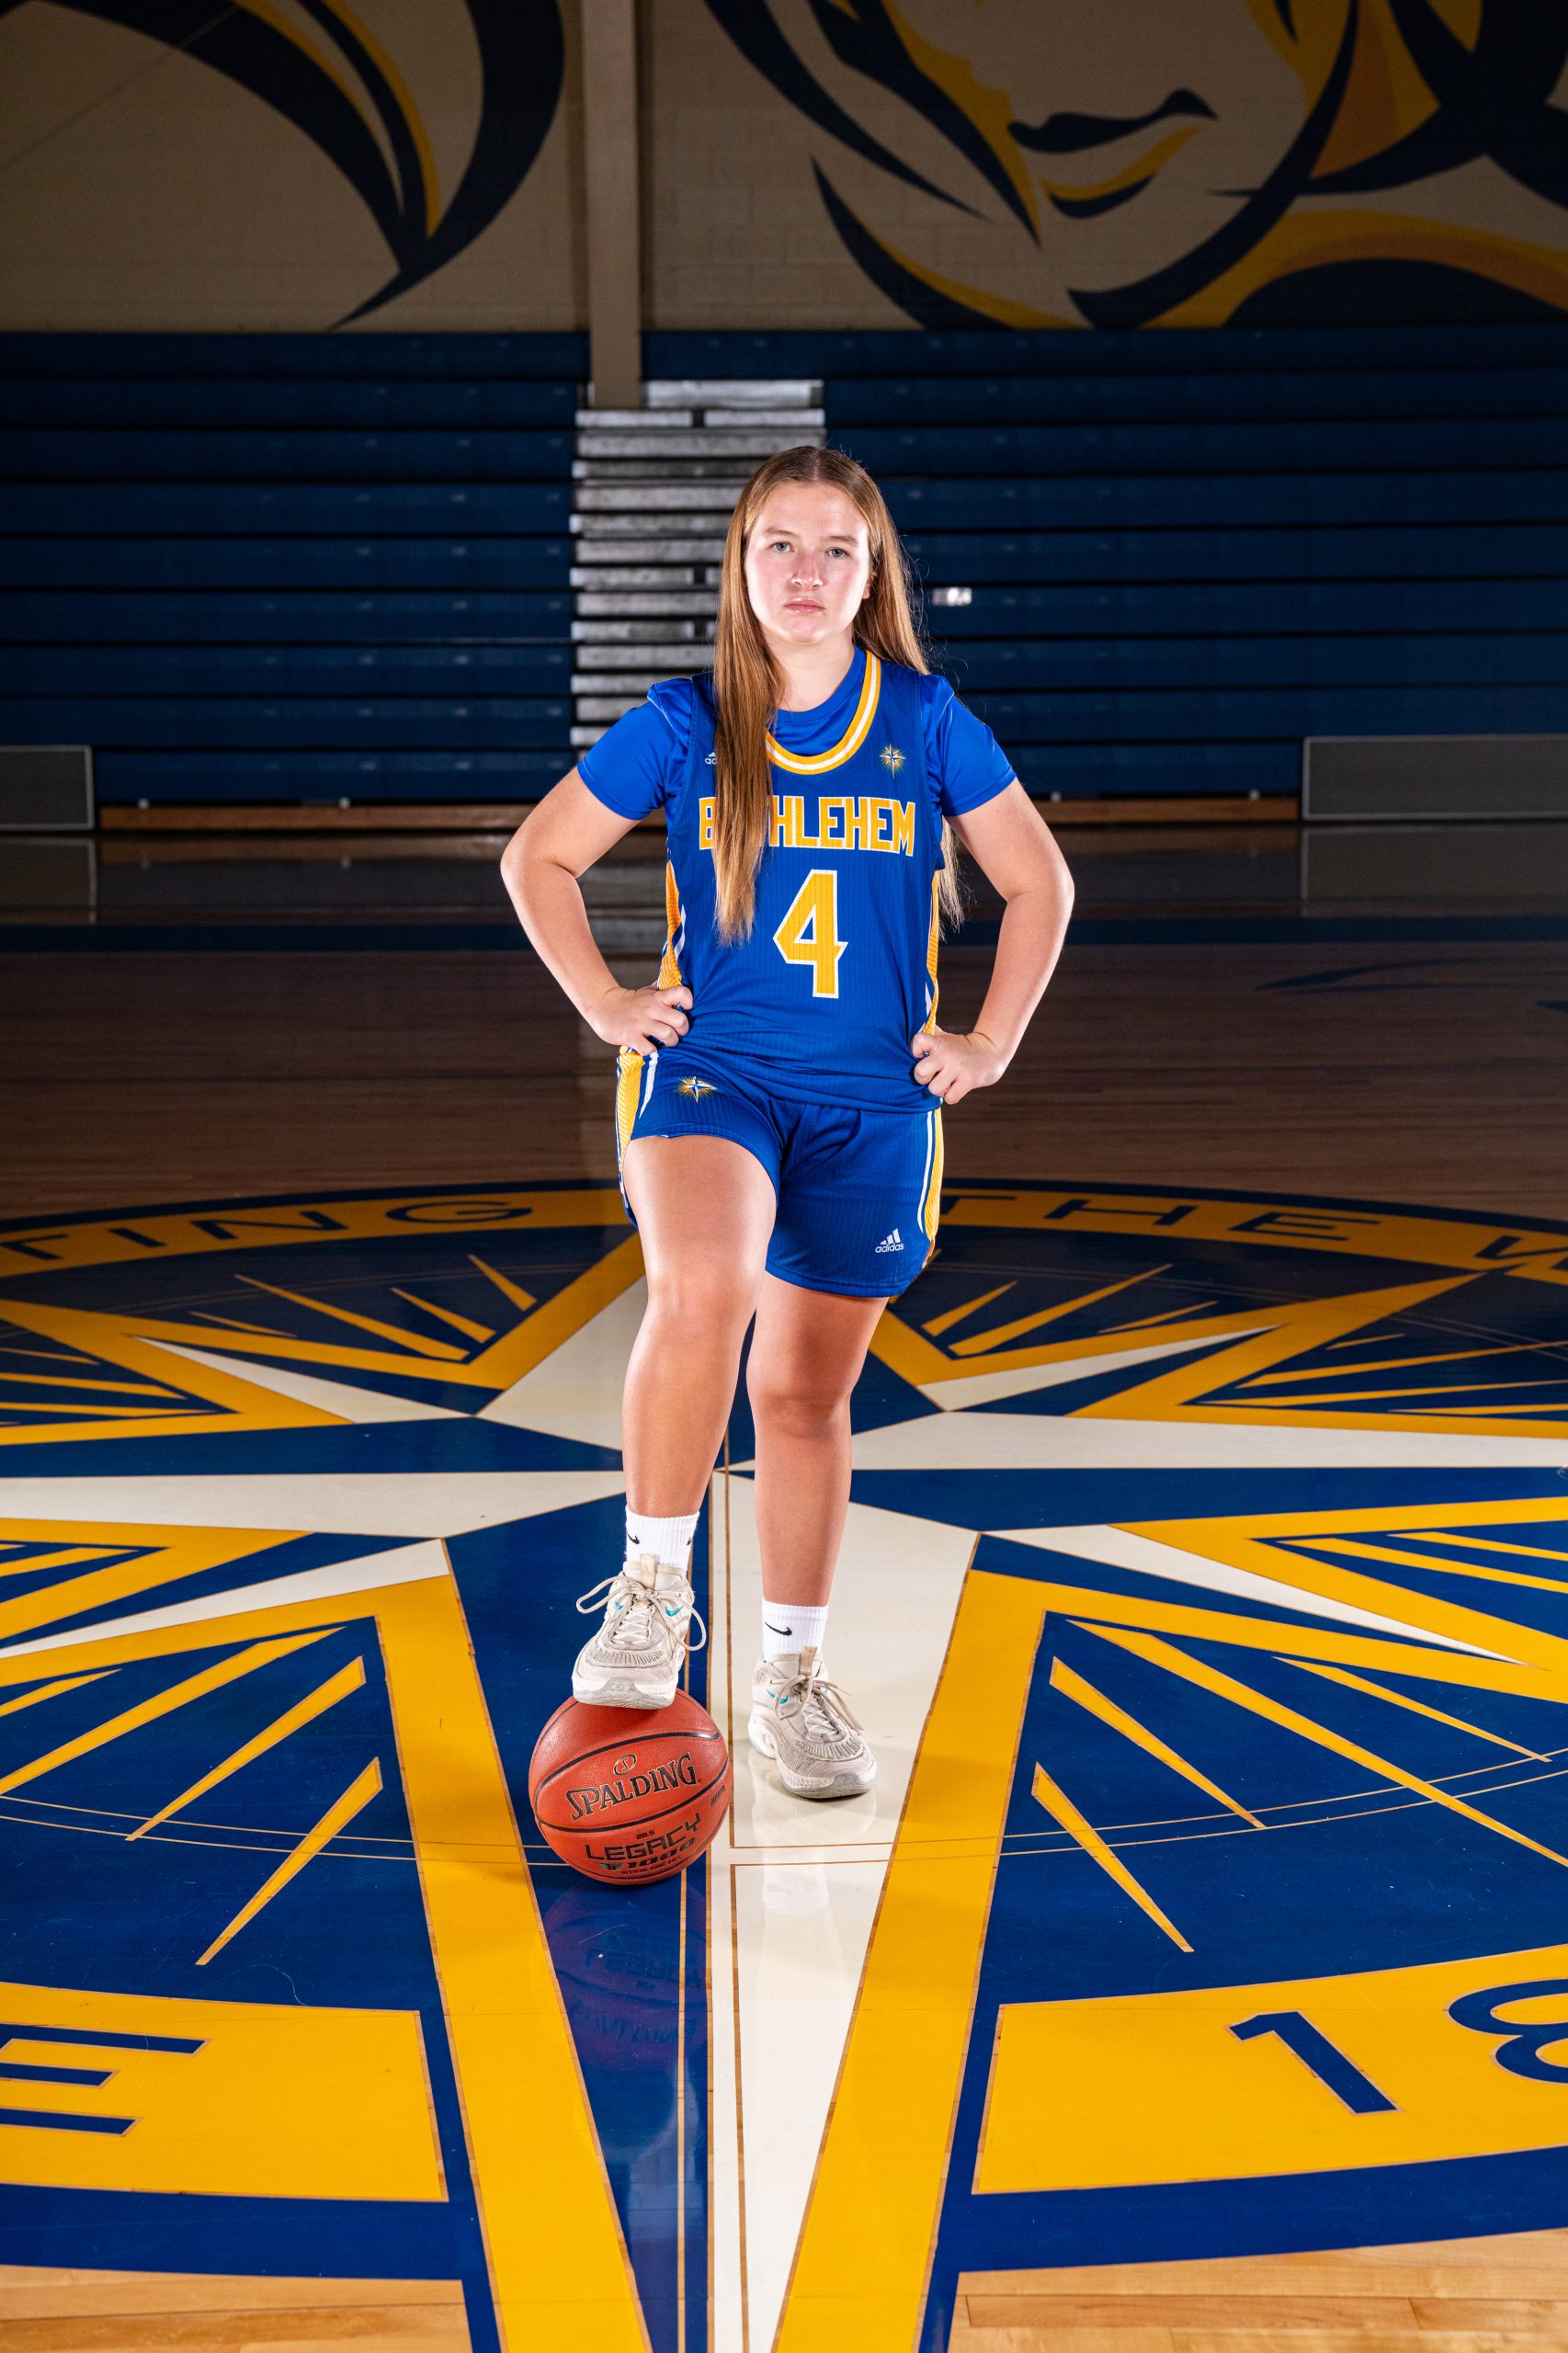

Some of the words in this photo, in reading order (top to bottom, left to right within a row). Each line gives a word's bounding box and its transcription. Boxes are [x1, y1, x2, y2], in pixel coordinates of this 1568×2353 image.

[699, 796, 915, 857] BHLEHEM
[773, 869, 848, 999] 4
[875, 1243, 904, 1254] adidas
[565, 1753, 697, 1821] SPALDING
[585, 1813, 701, 1861] LEGACY
